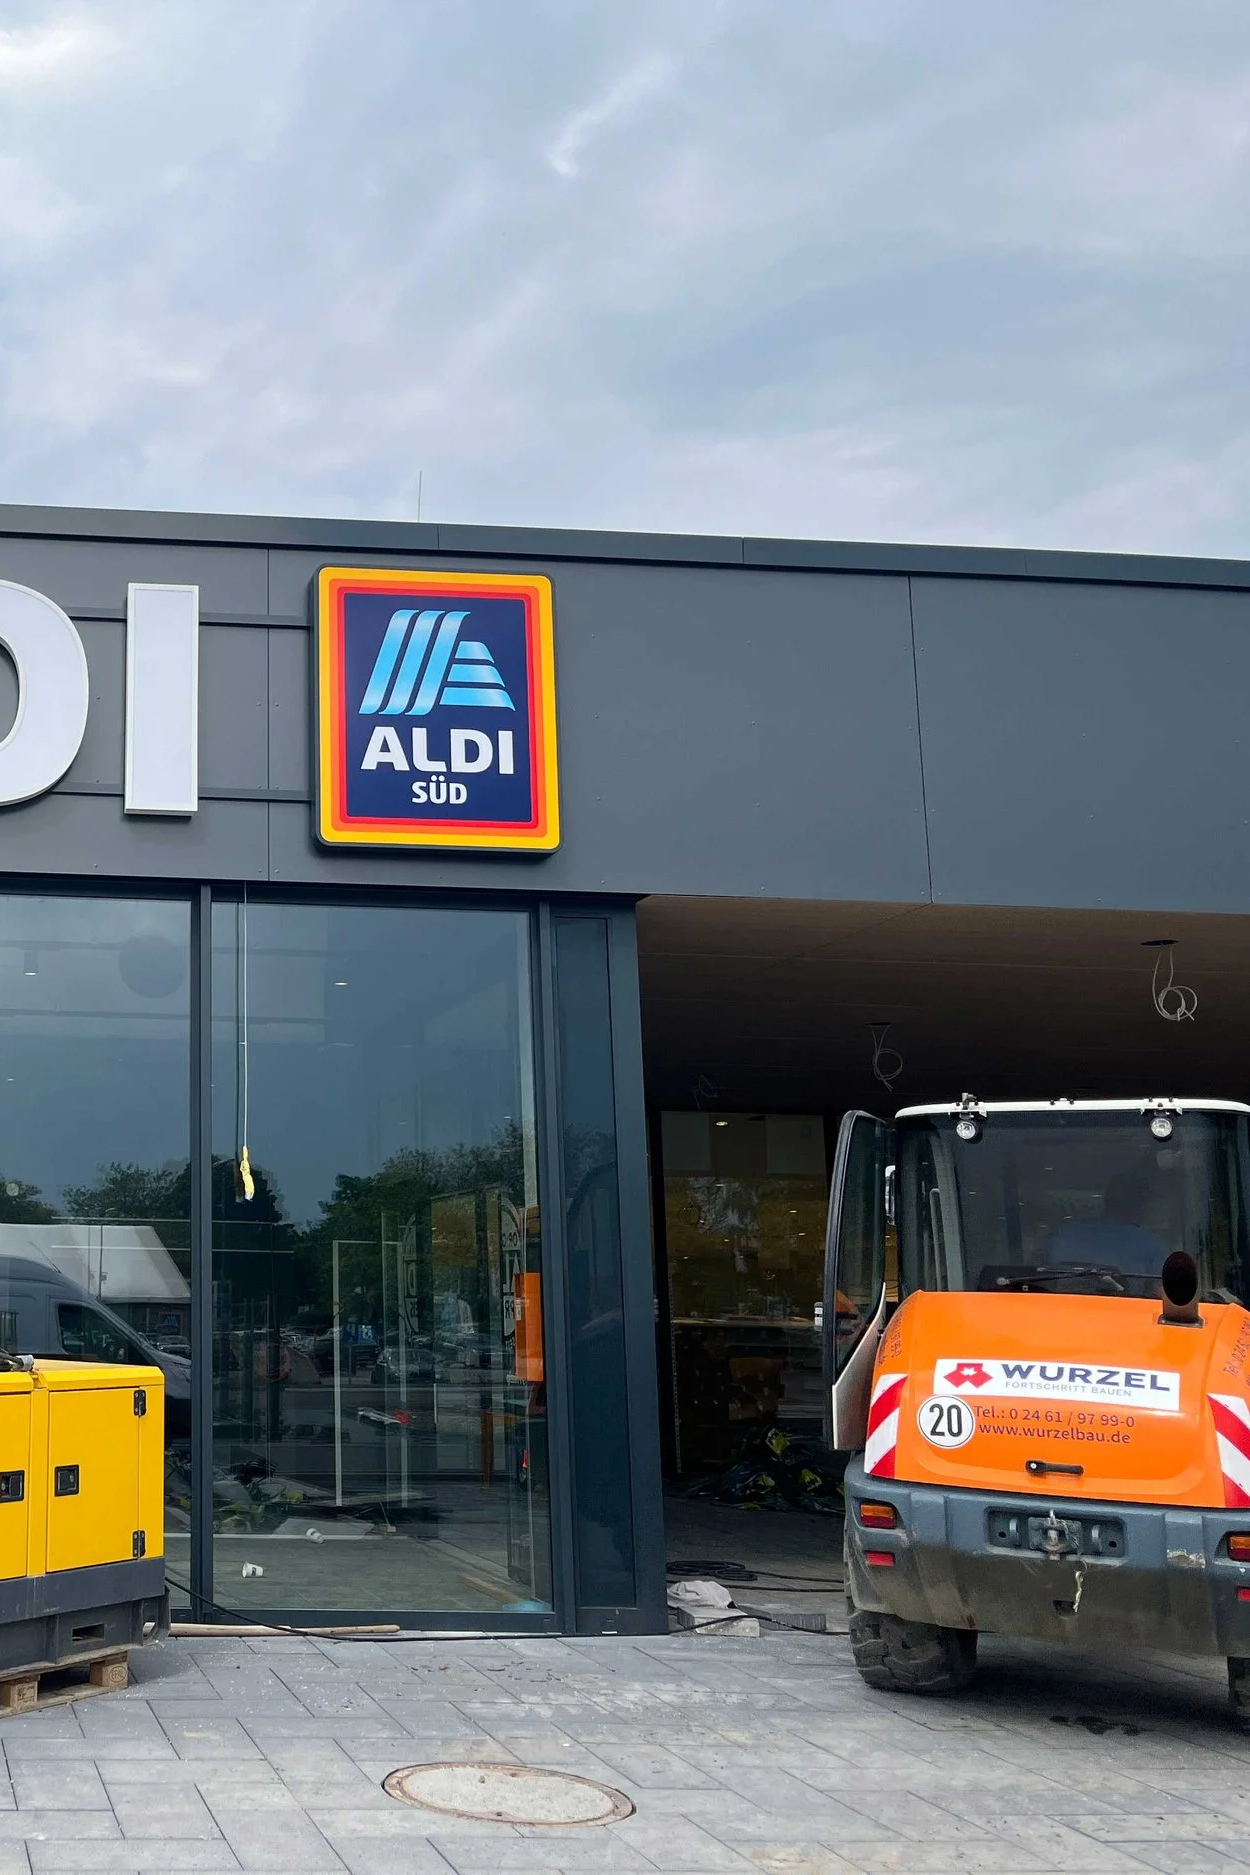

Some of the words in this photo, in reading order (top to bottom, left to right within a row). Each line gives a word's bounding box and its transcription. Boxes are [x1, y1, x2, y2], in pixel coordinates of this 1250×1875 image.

[360, 726, 514, 774] ALDI
[411, 775, 468, 804] SÜD
[1002, 1363, 1170, 1392] WURZEL
[1006, 1381, 1087, 1393] FORTSCHRITT
[1091, 1386, 1131, 1397] BAUEN
[929, 1403, 963, 1437] 20
[974, 1405, 1005, 1419] Tel.:
[1010, 1408, 1018, 1419] 0
[1023, 1409, 1041, 1421] 24
[1045, 1411, 1063, 1423] 61
[1077, 1413, 1095, 1425] 97
[1101, 1415, 1135, 1428] 99-0
[979, 1424, 1131, 1444] www.wurzelbau.de
